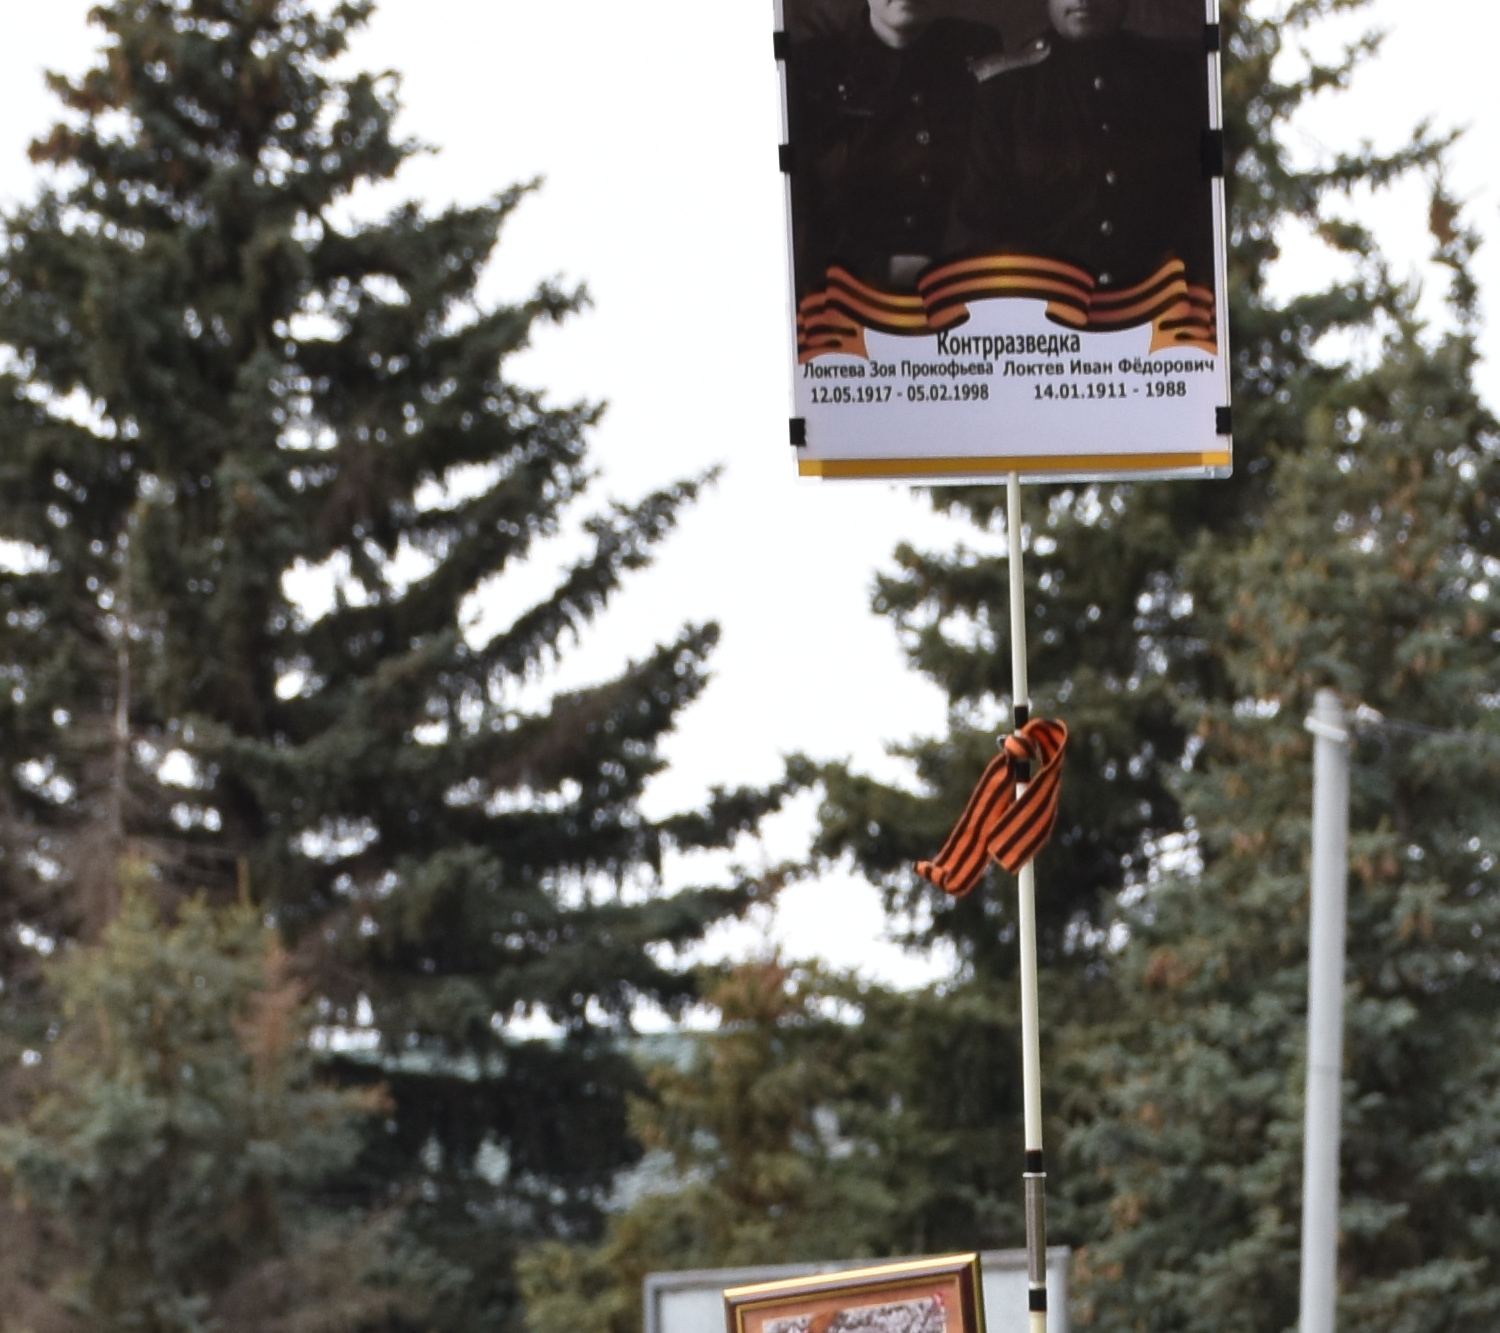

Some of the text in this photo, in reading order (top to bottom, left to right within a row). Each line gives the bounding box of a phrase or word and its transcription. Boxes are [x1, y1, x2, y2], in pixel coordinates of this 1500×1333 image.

[937, 331, 1081, 360] Контрразведка
[803, 360, 994, 380] Локтева Зоя Прокофьева
[1003, 357, 1215, 378] Локтев Иван Фёдорович
[811, 385, 893, 404] 12.05.1917
[908, 384, 990, 403] 05.02.1998
[1033, 383, 1128, 400] 14.01.1911
[1146, 382, 1187, 399] 1988
